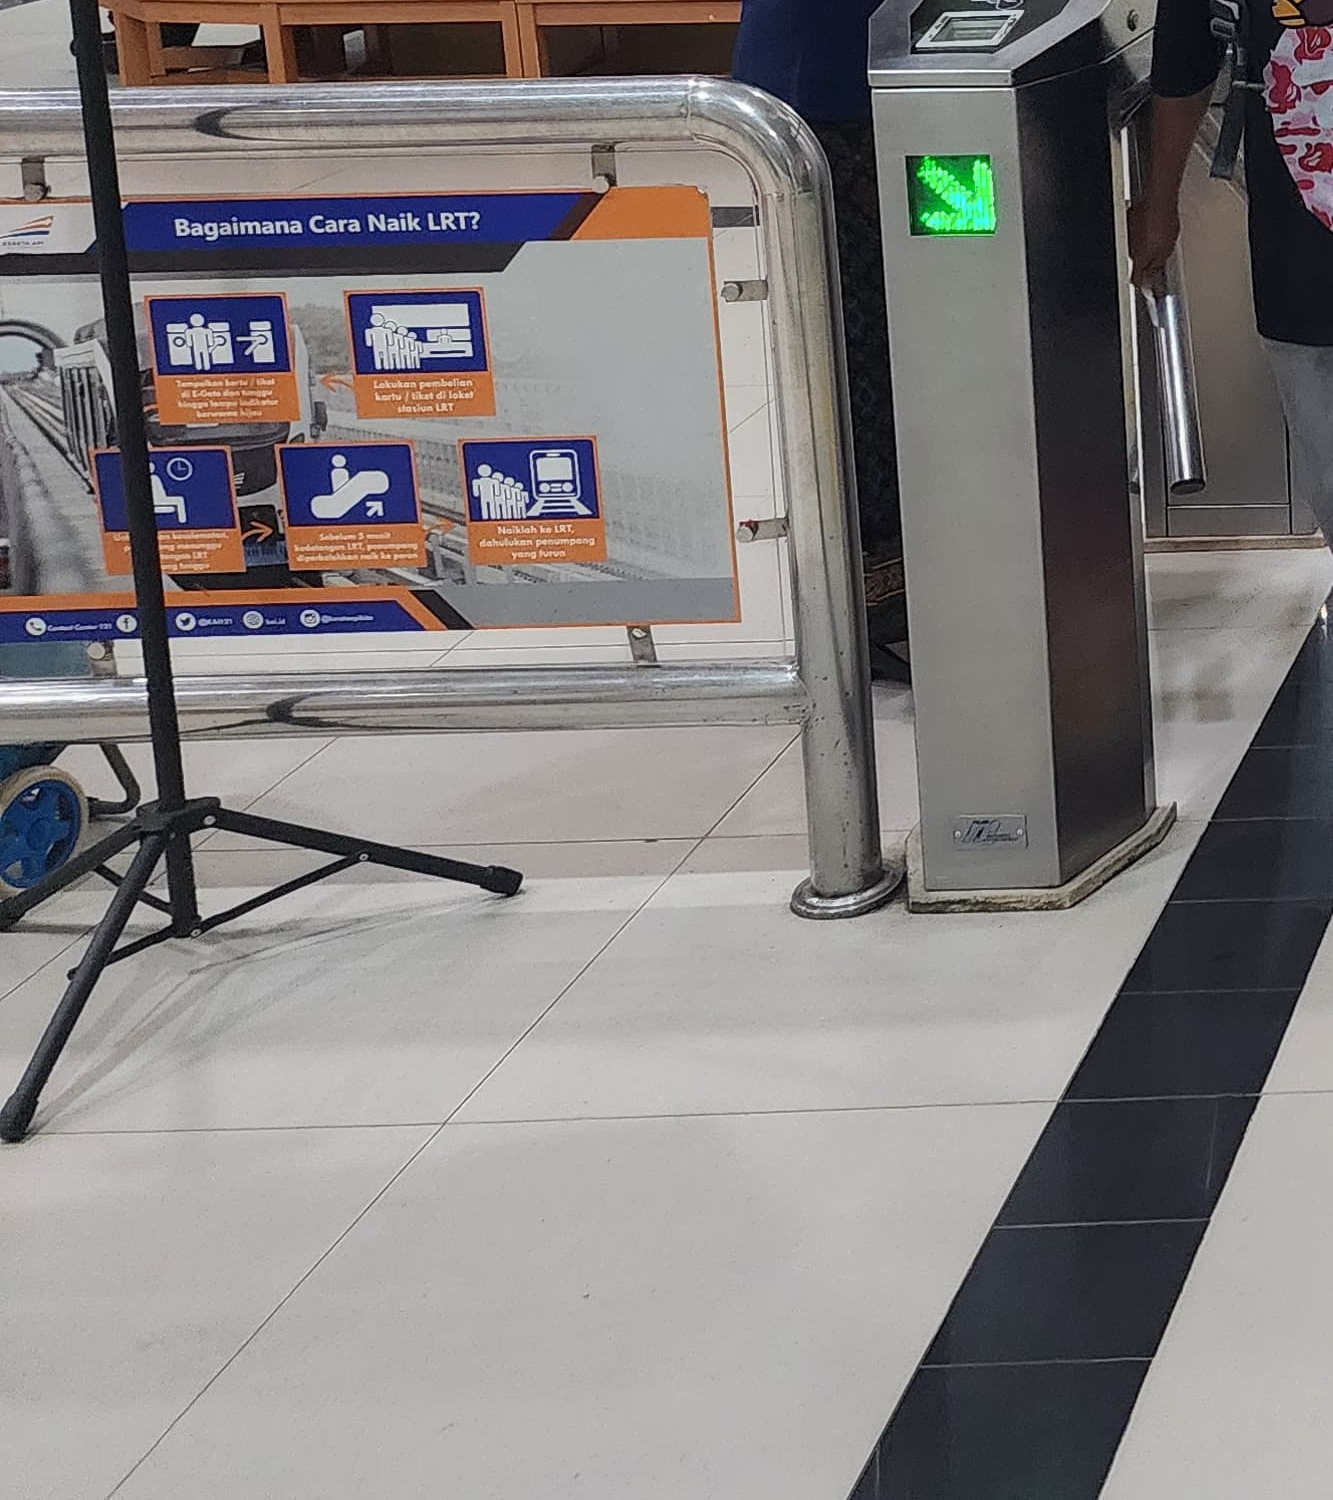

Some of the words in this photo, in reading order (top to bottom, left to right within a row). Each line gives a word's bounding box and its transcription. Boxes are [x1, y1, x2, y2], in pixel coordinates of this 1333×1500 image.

[174, 215, 303, 241] Bagaimana
[308, 215, 361, 234] Cara
[367, 212, 421, 232] Naik
[427, 211, 481, 231] LRT?
[373, 380, 416, 389] Lakukan
[419, 379, 473, 389] pembelian
[375, 392, 401, 401] kartu
[412, 391, 433, 400] tiket
[436, 391, 446, 400] di
[449, 391, 473, 400] loket
[397, 404, 433, 413] stasiun
[436, 403, 454, 412] LRT
[497, 525, 538, 535] Naiklah
[540, 525, 552, 534] ke
[554, 525, 575, 534] LRT,
[319, 533, 356, 541] Sebelum
[479, 538, 533, 548] dahulukan
[535, 537, 595, 548] penumpang
[511, 551, 537, 560] yang
[539, 550, 566, 558] turun
